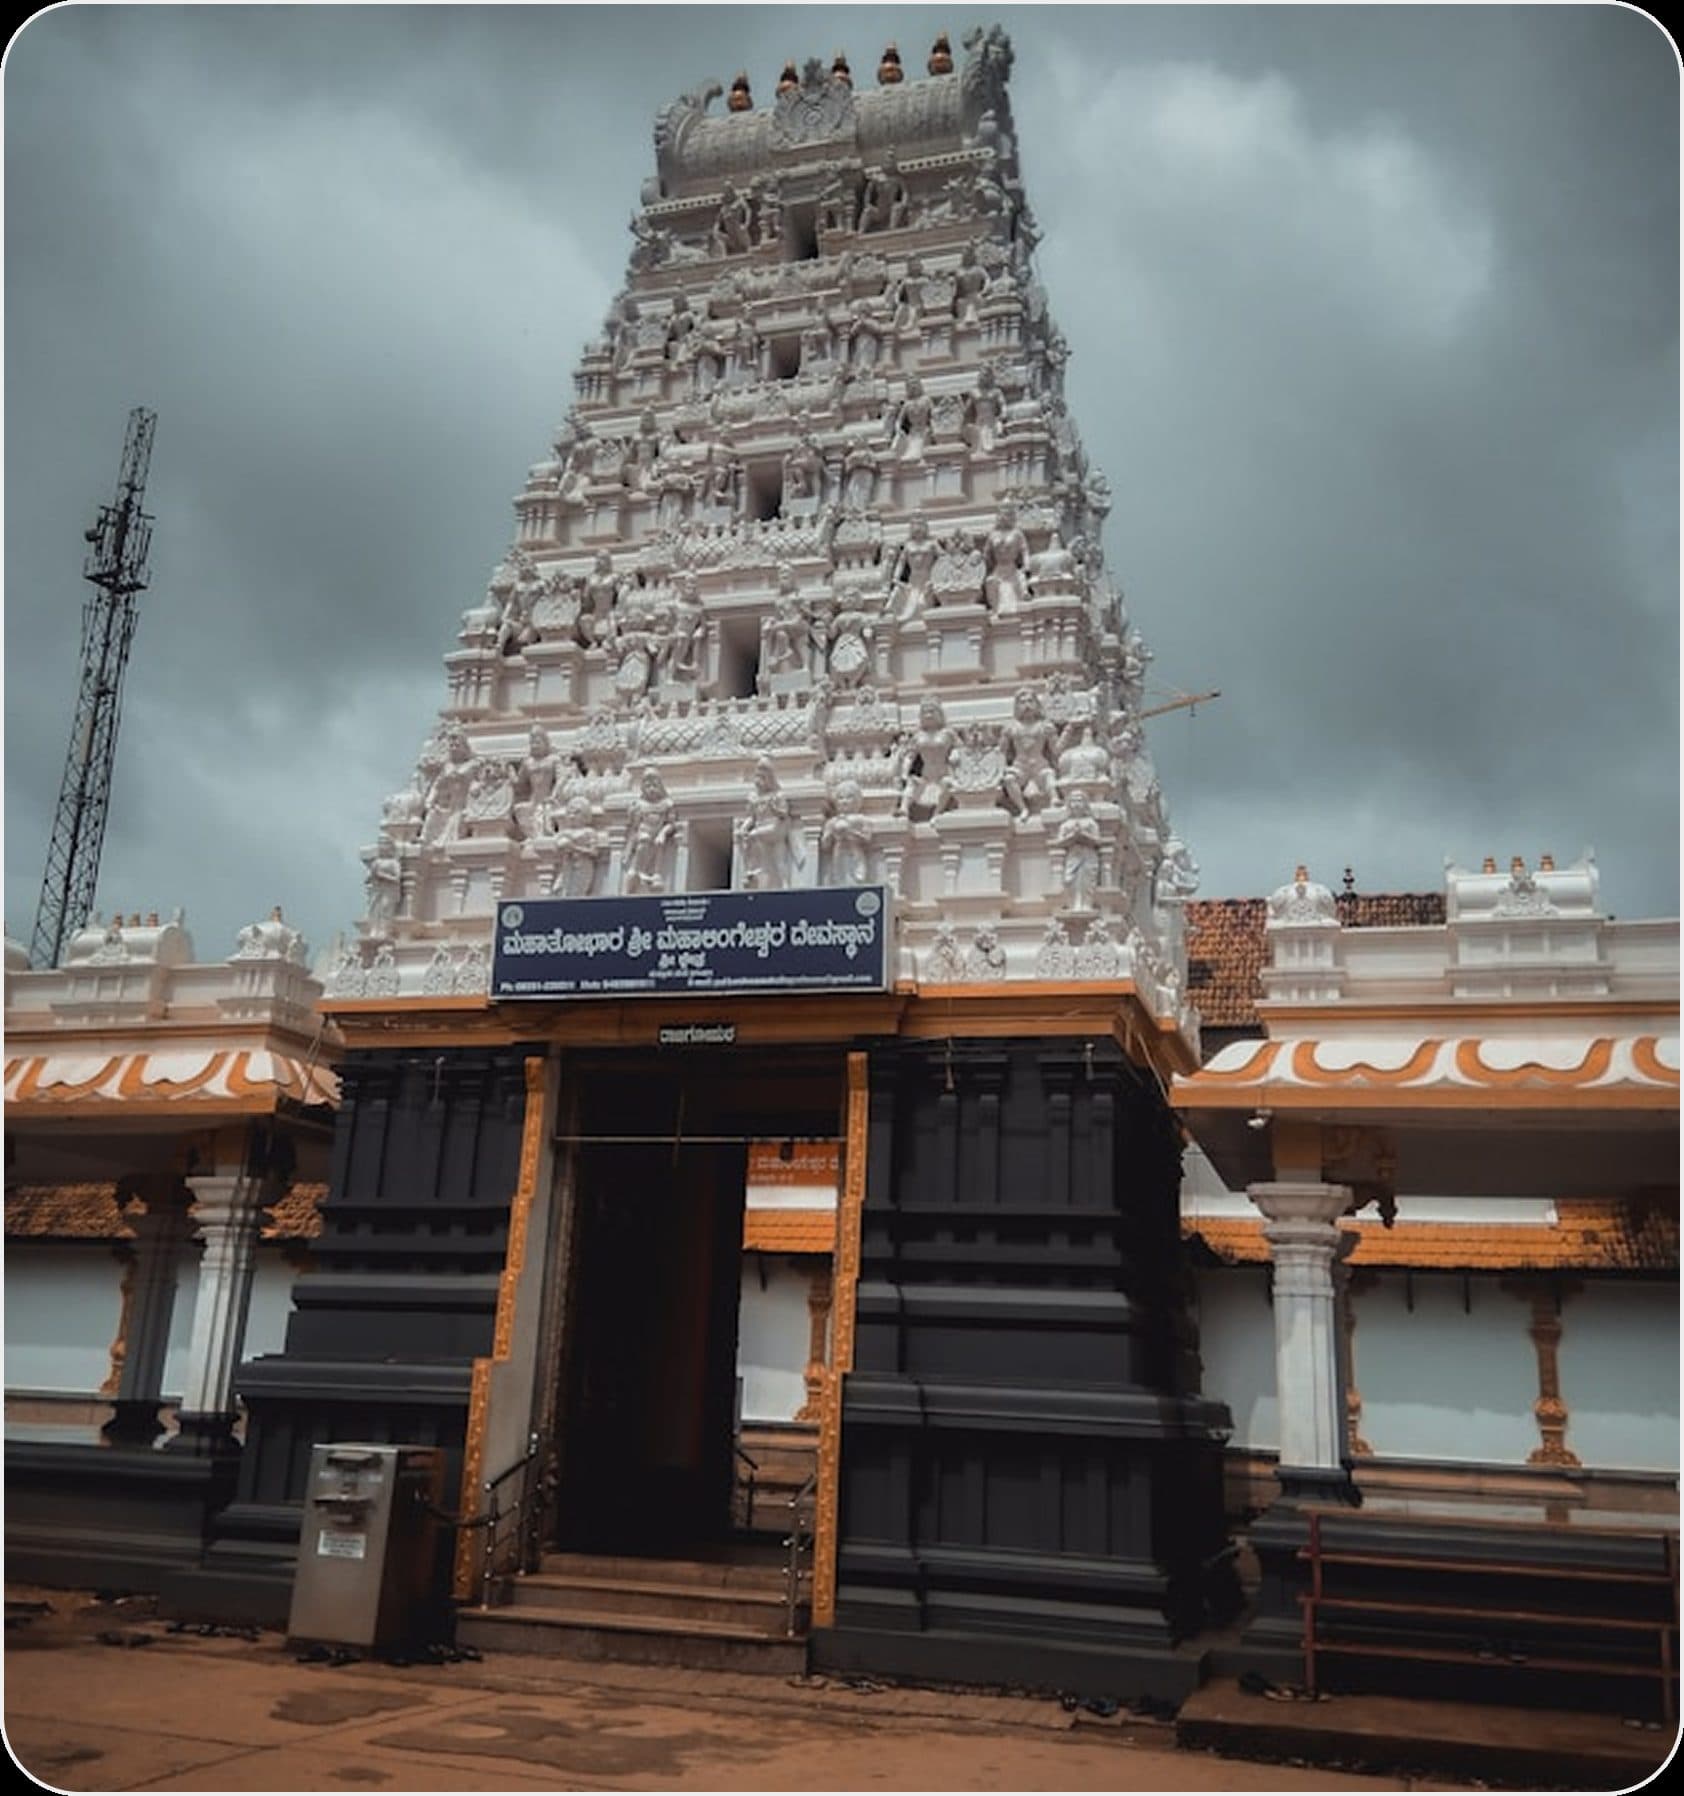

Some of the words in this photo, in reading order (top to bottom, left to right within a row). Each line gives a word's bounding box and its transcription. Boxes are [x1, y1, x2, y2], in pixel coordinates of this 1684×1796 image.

[627, 925, 652, 958] ಶ್ರೀ
[656, 921, 786, 957] ಮಹಾಲಿಂಗೇಶ್ವರ
[790, 918, 874, 959] ದೇವಸ್ಥಾನ
